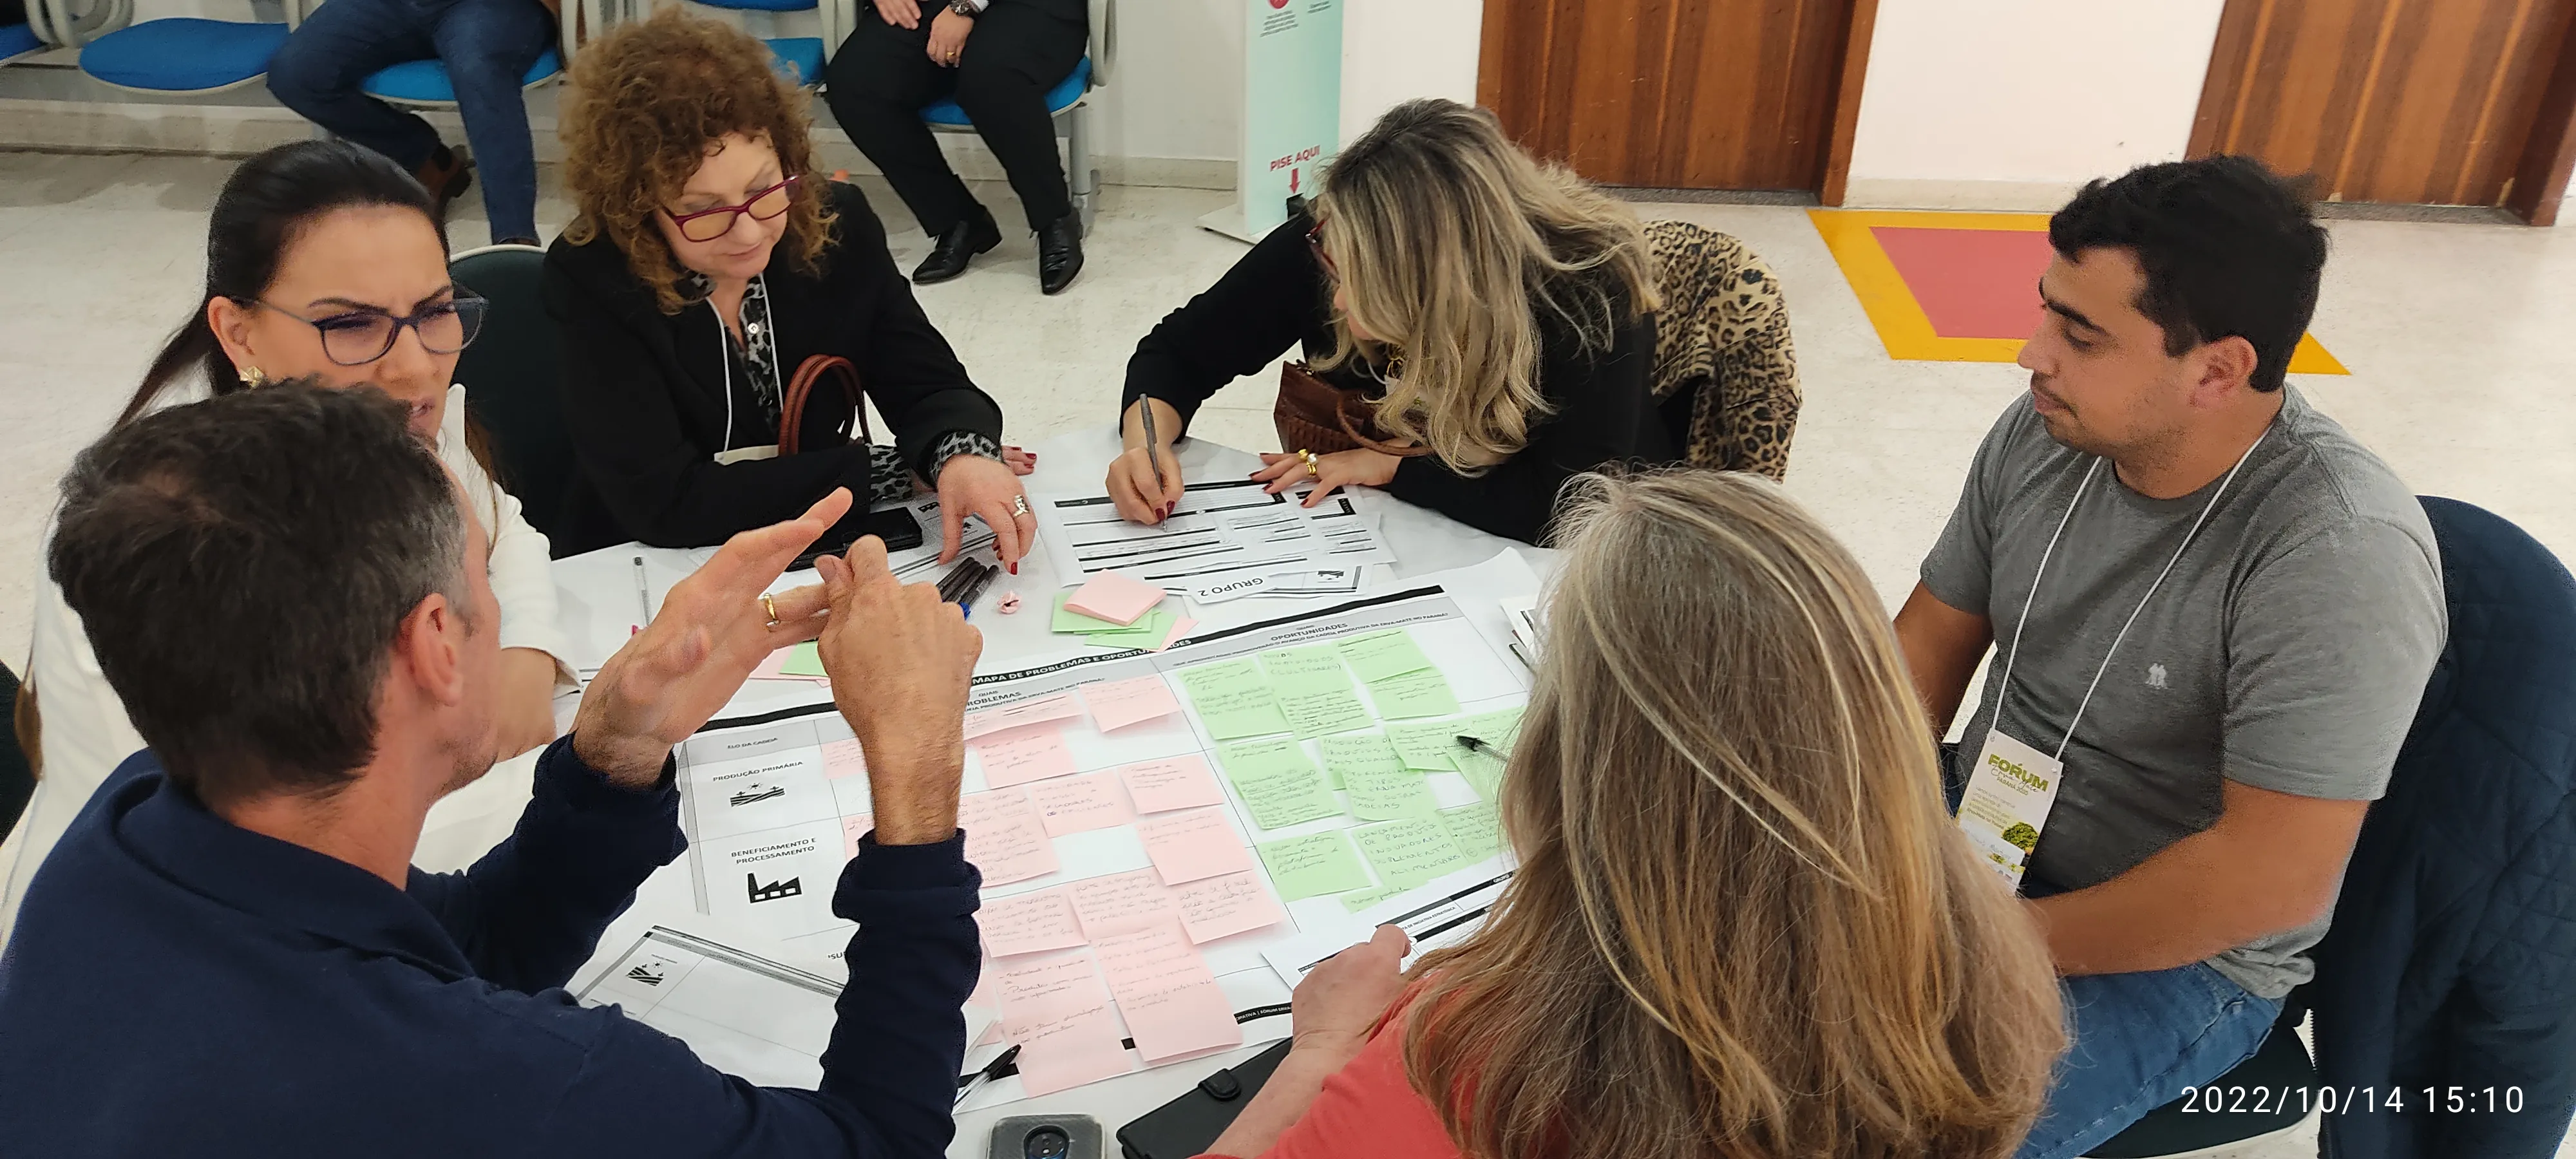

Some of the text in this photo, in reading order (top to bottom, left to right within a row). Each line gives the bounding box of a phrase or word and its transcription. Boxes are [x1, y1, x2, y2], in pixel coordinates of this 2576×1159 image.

[1270, 145, 1320, 172] PISE AQUI
[1211, 578, 1264, 594] GRUPO
[1271, 623, 1348, 641] OPORTUNIDADES
[972, 675, 1007, 684] MAPA
[1026, 657, 1091, 676] PROBLEMAS
[1101, 639, 1192, 661] OPORTUDES
[967, 691, 1022, 706] ROBLEMAS
[980, 698, 1018, 708] PRODUTIVA
[713, 761, 803, 782] PRODUÇÃO PRIMÁRIA
[731, 839, 810, 857] BENEFICIAMENTO
[736, 845, 815, 864] PROCESSAMENTO
